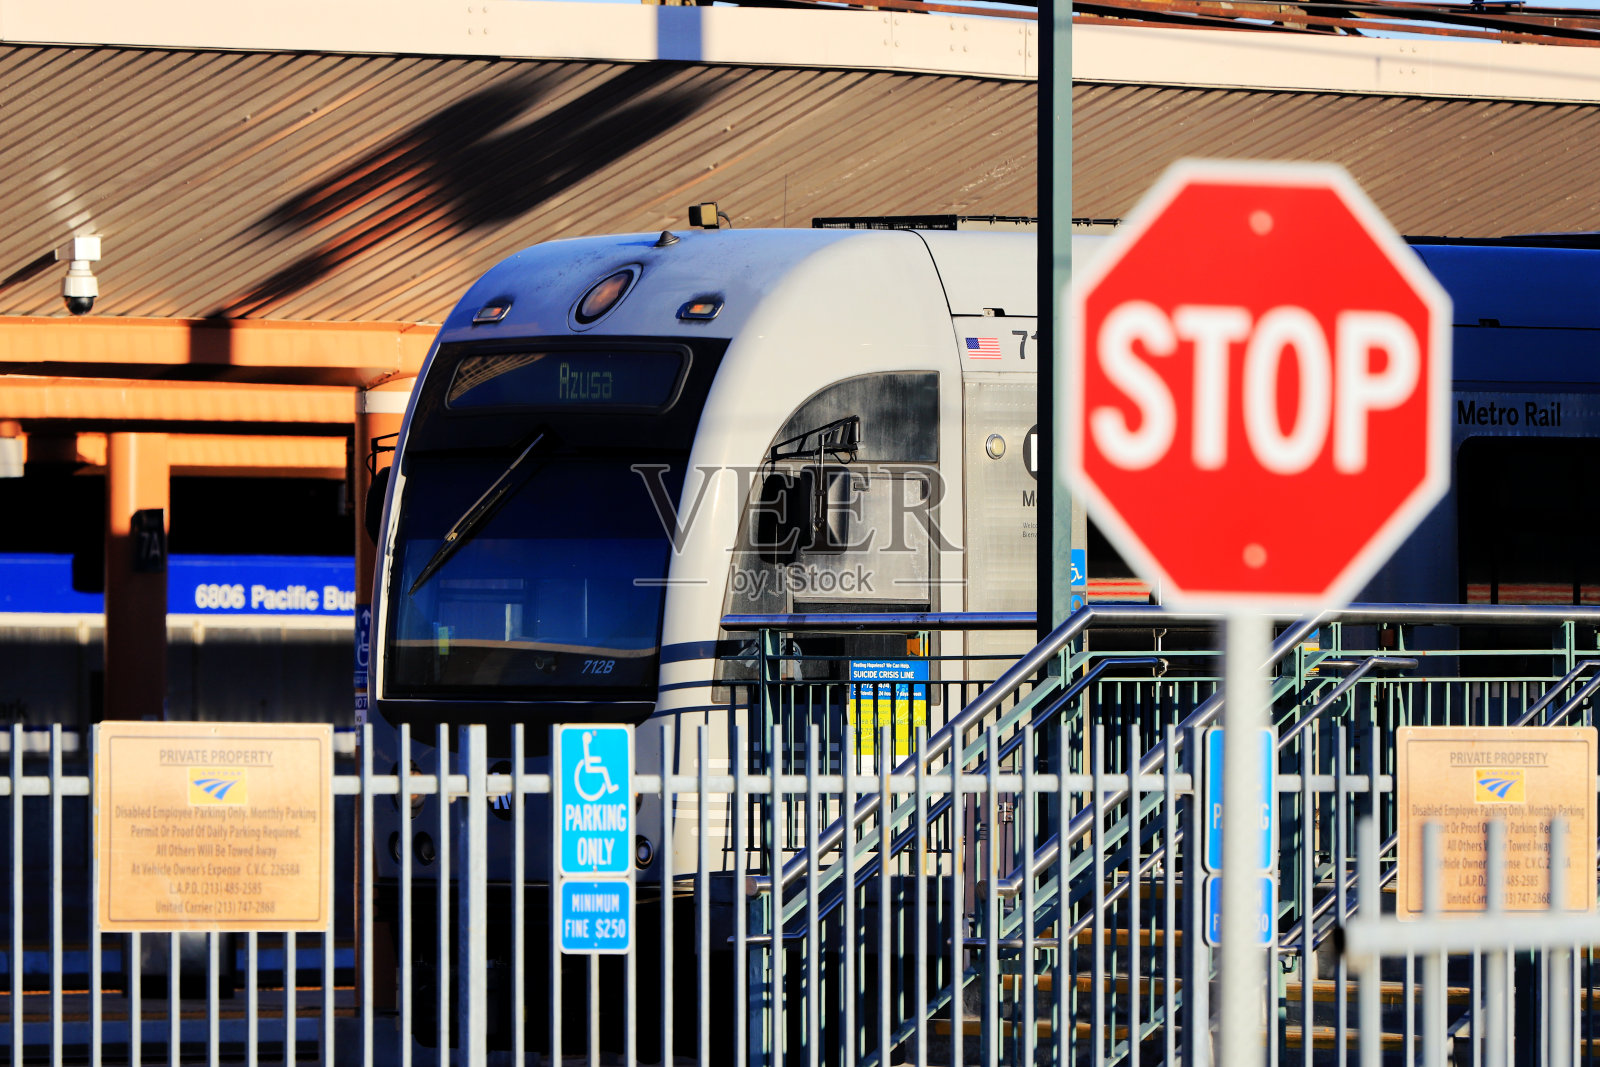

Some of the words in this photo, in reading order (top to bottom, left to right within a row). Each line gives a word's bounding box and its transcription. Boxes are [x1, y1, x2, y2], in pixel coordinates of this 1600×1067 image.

[560, 362, 612, 399] Azusa
[1090, 299, 1421, 475] STOP
[1457, 400, 1519, 426] Metro
[1525, 402, 1561, 427] Rail
[140, 531, 161, 560] 7A
[195, 584, 245, 609] 6806
[251, 585, 319, 611] Pacific
[581, 660, 616, 674] 712B
[853, 670, 878, 679] SUICIDE
[878, 671, 899, 679] CRISIS
[900, 671, 914, 679] LINE
[159, 749, 208, 763] PRIVATE
[211, 750, 273, 764] PROPERTY
[1450, 751, 1492, 764] PRIVATE
[1494, 752, 1548, 765] PROPERTY
[115, 805, 151, 819] Disabled
[153, 806, 193, 823] Employee
[194, 806, 226, 823] Parking
[251, 807, 284, 824] Monthly
[286, 808, 317, 825] Parking
[565, 803, 627, 832] PARKING
[1412, 804, 1443, 817] Disabled
[1445, 805, 1479, 820] Employee
[1480, 805, 1507, 821] Parking
[1528, 805, 1556, 821] Monthly
[1558, 805, 1585, 821] Parking
[131, 825, 159, 838] Permit
[161, 825, 171, 838] Or
[172, 825, 194, 838] Proof
[196, 825, 206, 838] Of
[207, 825, 228, 841] Daily
[230, 825, 261, 841] Parking
[1451, 822, 1460, 834] Or
[1461, 822, 1480, 834] Proof
[1510, 823, 1537, 837] Parking
[156, 845, 167, 857] All
[169, 845, 196, 857] Others
[197, 845, 213, 857] Will
[215, 845, 226, 857] Be
[227, 846, 254, 858] Towed
[256, 846, 277, 861] Away
[577, 837, 615, 866] ONLY
[1447, 840, 1457, 852] All
[1458, 840, 1482, 852] Others
[1508, 840, 1533, 852] Towed
[143, 863, 171, 876] Vehicle
[173, 863, 207, 876] Owner's
[208, 863, 241, 878] Expense
[201, 882, 224, 896] (213)
[225, 882, 262, 895] 485-2585
[571, 893, 620, 913] MINIMUM
[1447, 892, 1470, 904] United
[155, 901, 183, 913] United
[185, 901, 213, 913] Carrier
[214, 901, 236, 915] (213)
[238, 901, 275, 914] 747-2868
[565, 918, 589, 938] FINE
[595, 918, 626, 939] $250
